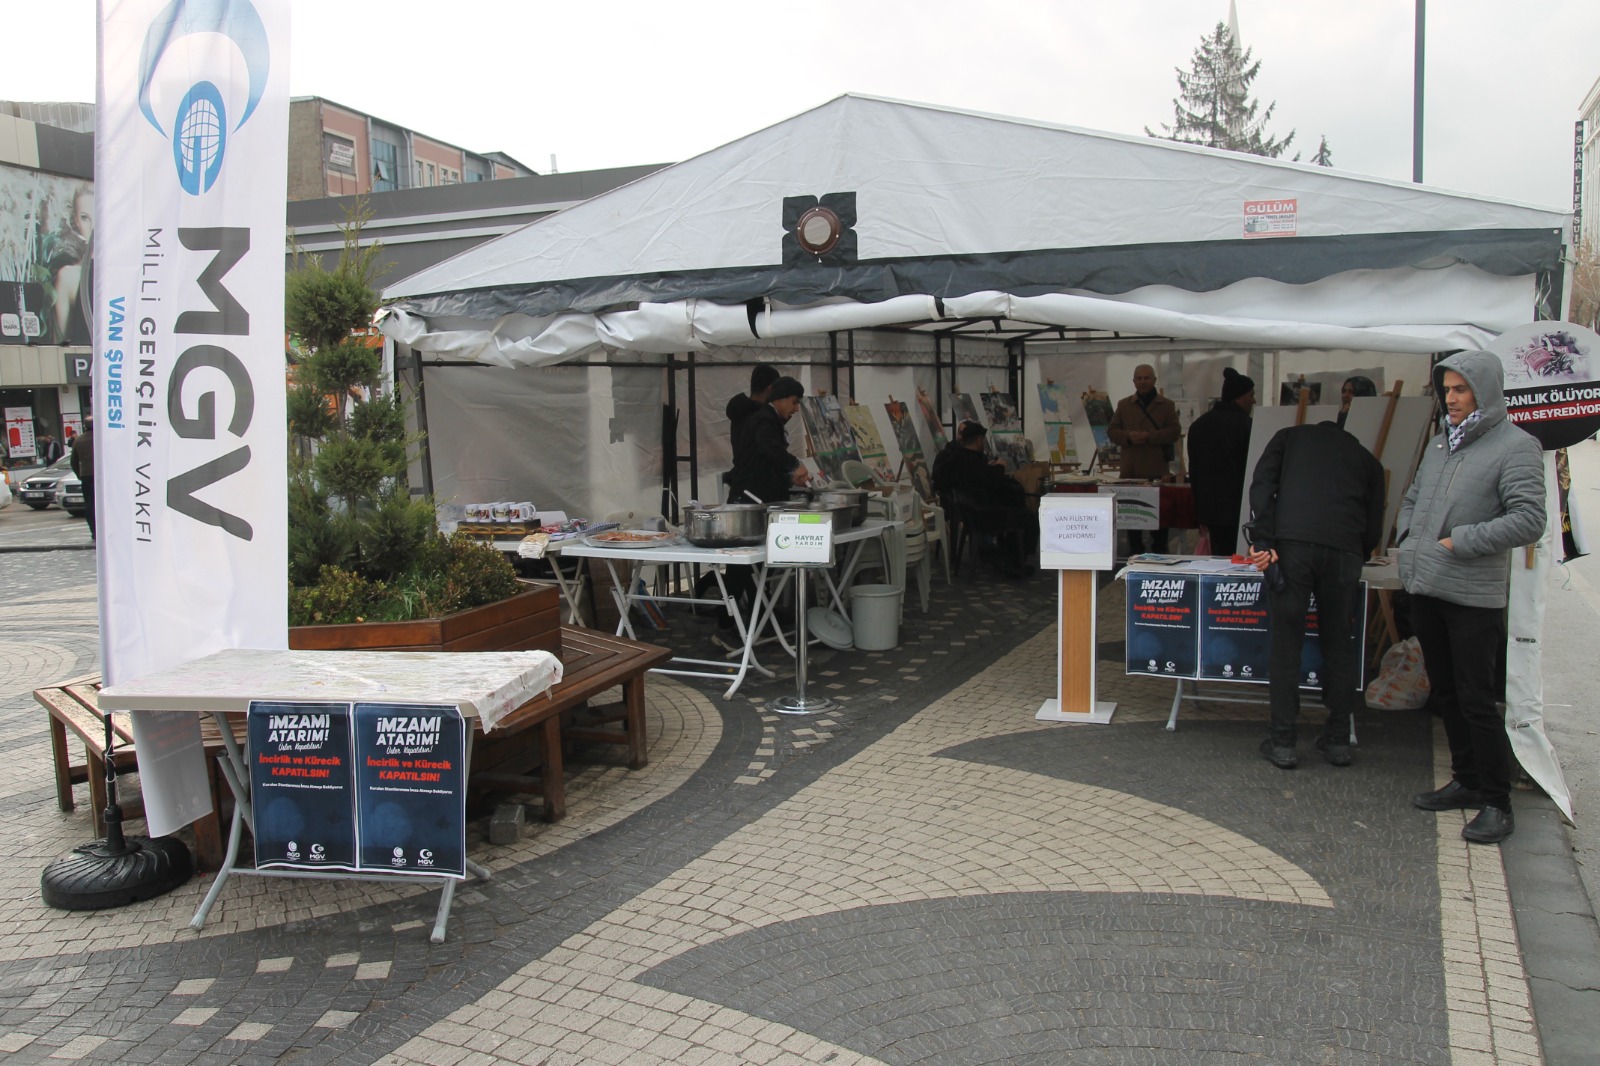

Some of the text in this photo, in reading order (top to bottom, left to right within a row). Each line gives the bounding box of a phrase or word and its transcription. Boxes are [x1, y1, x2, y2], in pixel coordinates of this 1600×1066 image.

[1246, 201, 1294, 213] GÜLÜM
[104, 296, 126, 429] VAN ŞUBESİ
[135, 228, 164, 543] MİLLİ GENÇLİK VAKFI
[167, 227, 255, 541] MGV
[1140, 590, 1184, 598] ATARIM!
[1214, 593, 1259, 601] ATARIM!
[268, 729, 329, 742] ATARIM!
[376, 733, 440, 745] ATARIM!
[259, 752, 291, 764] İncirlik
[305, 755, 341, 766] Kürecik
[367, 756, 451, 770] İncirlik ve Kürecik
[272, 767, 330, 778] KAPATILSIN!
[379, 771, 440, 782] KAPATILSIN!
